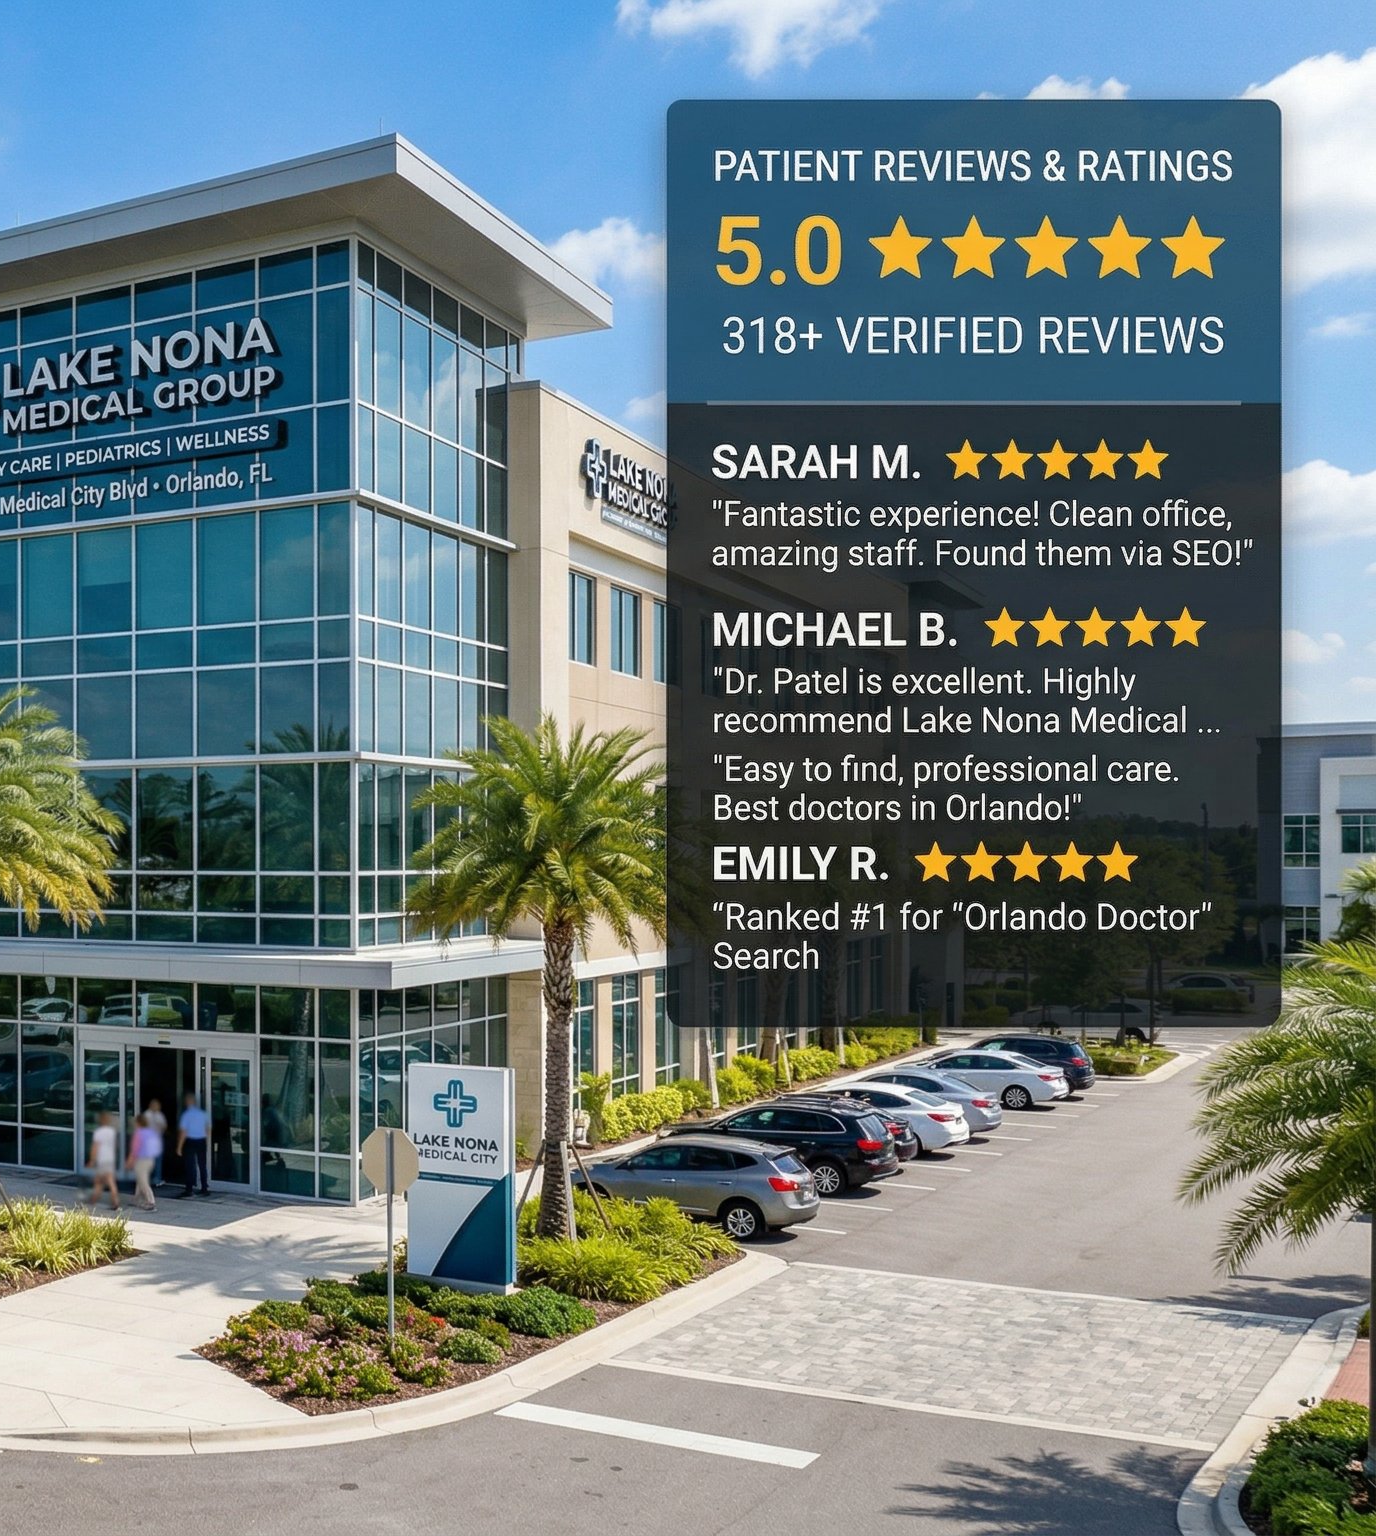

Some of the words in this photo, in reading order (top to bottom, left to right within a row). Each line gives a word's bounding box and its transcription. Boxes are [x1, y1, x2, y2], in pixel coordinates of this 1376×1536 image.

[3, 344, 115, 398] LAKE
[131, 317, 275, 376] NONA
[3, 388, 143, 434] MEDICAL
[153, 366, 276, 409] GROUP
[10, 455, 52, 475] CARE
[65, 439, 162, 467] PEDIATRICS
[175, 424, 270, 451] WELLNESS
[610, 449, 643, 491] LAKE
[0, 487, 66, 515] Medical
[71, 482, 105, 509] City
[109, 477, 148, 501] Blvd
[166, 466, 244, 494] Orlando,
[249, 463, 273, 484] FL
[413, 1132, 450, 1147] LAKE
[454, 1137, 499, 1151] NONA
[470, 1153, 498, 1164] CITY
